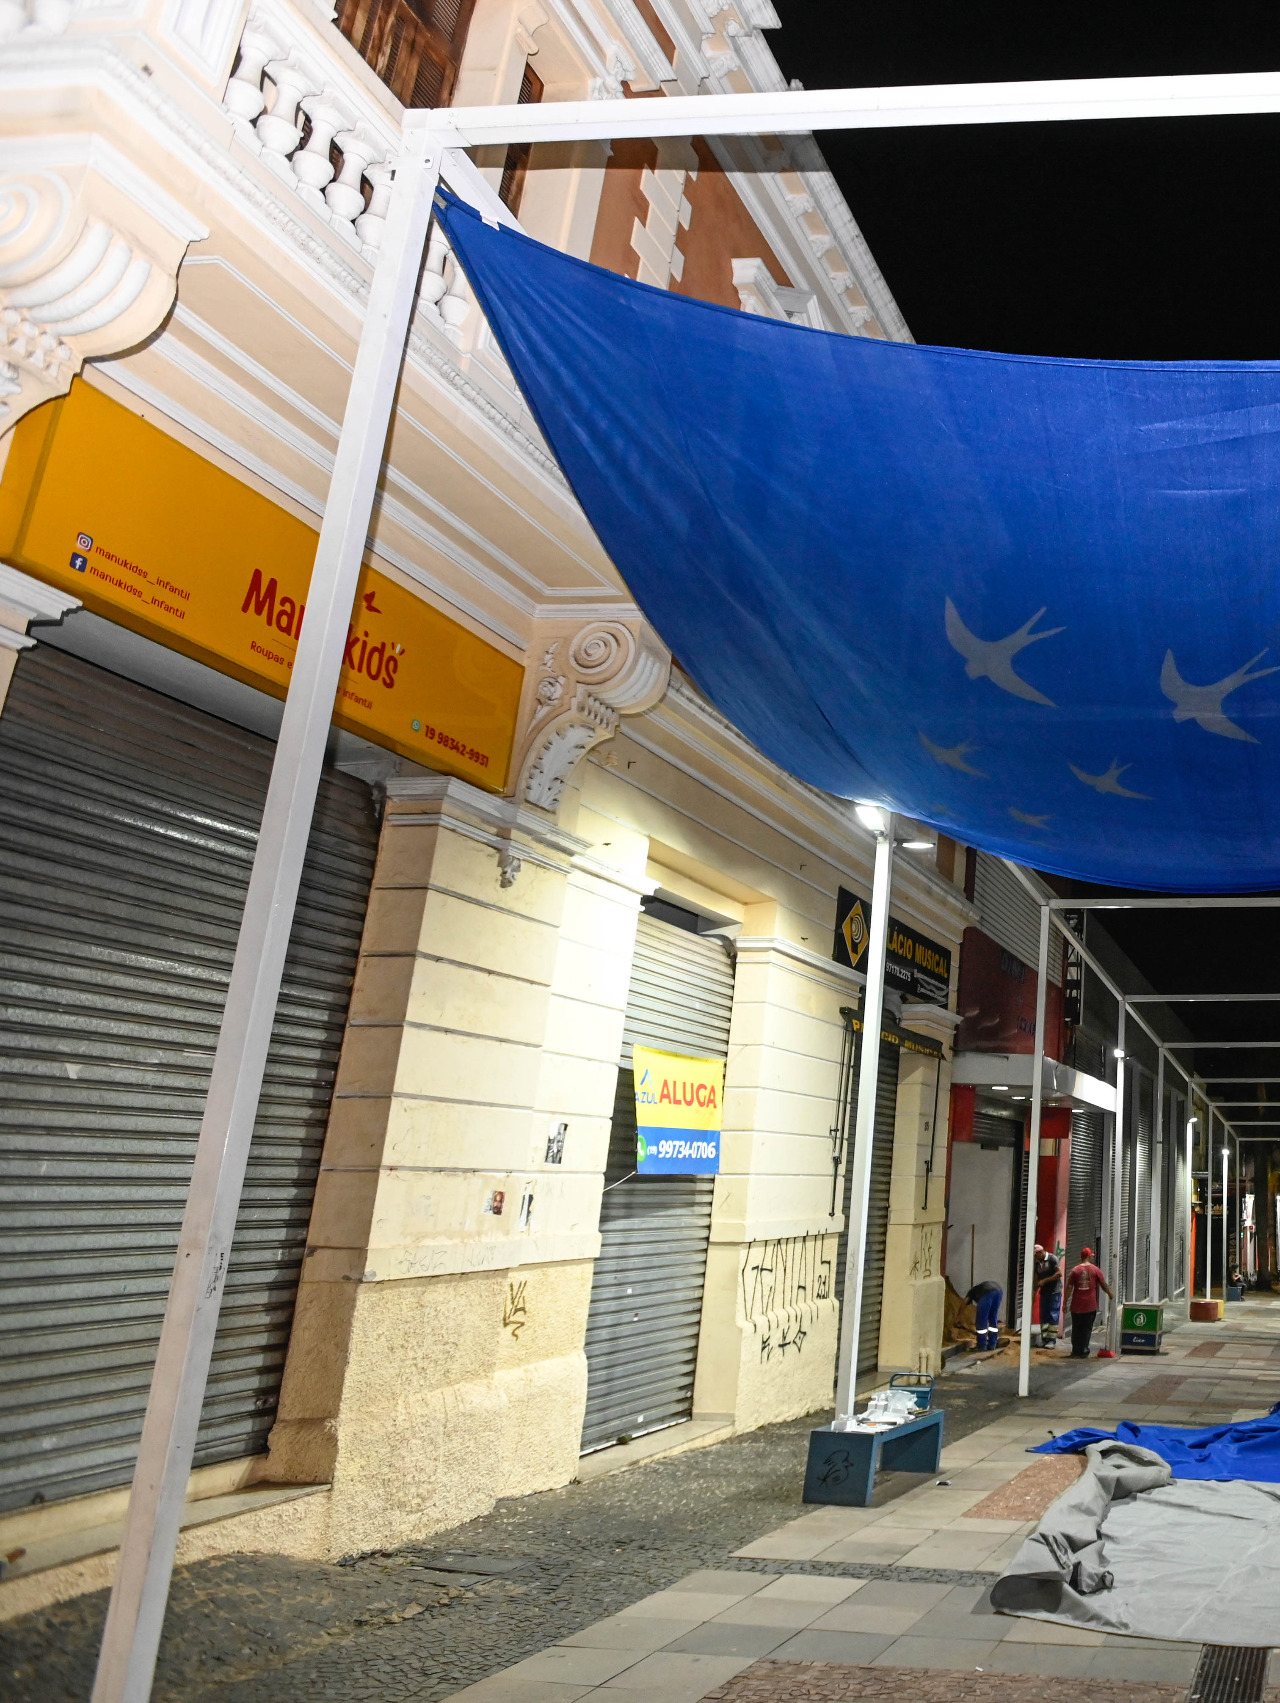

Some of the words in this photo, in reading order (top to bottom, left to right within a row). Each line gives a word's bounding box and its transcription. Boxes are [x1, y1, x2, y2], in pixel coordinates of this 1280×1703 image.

[250, 640, 285, 666] Roupas
[342, 688, 373, 710] infantil
[425, 724, 436, 741] 19
[437, 731, 490, 769] 98342-9931
[887, 926, 913, 960] LÁCIO
[914, 942, 948, 979] MUSICAL
[635, 1091, 658, 1105] AZUL
[659, 1079, 717, 1109] ALUGA
[658, 1140, 717, 1159] 99734-0706
